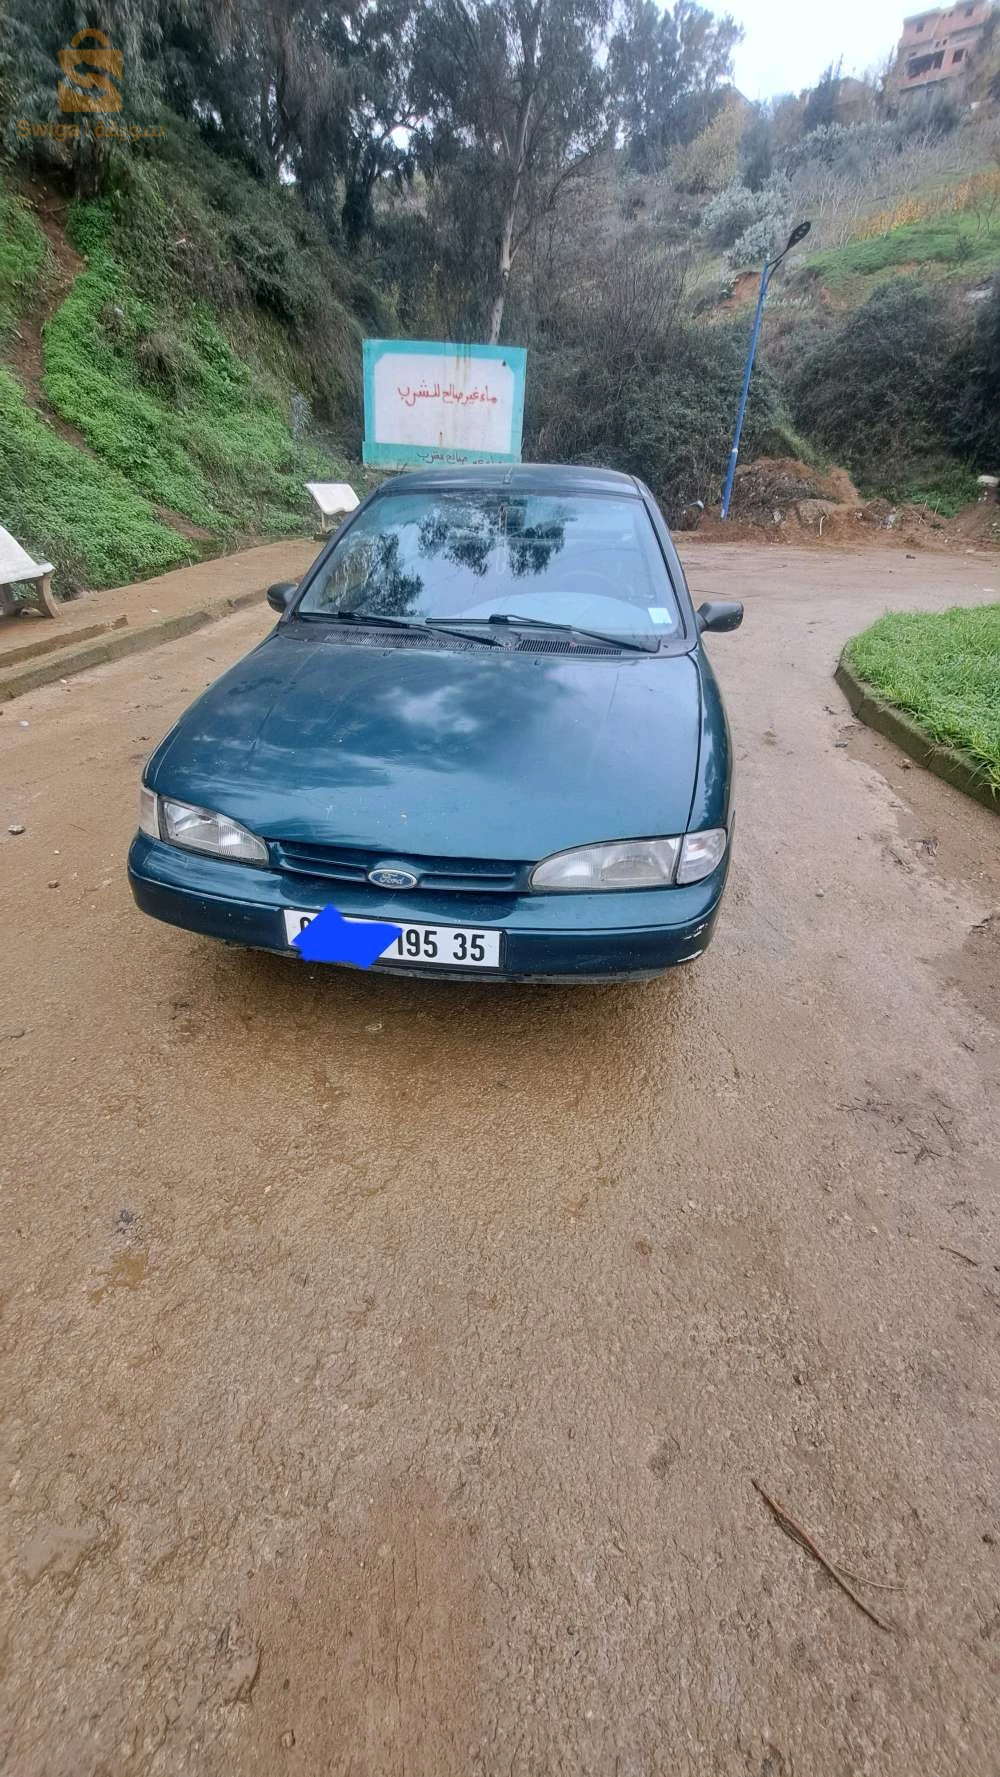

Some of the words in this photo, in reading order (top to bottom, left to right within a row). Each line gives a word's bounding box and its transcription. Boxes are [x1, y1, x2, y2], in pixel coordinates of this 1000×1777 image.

[397, 379, 440, 406] للشرب
[442, 383, 463, 404] صالح
[461, 386, 480, 406] غير
[480, 384, 497, 404] ماء
[379, 872, 406, 886] Ford
[397, 929, 438, 958] 195
[453, 933, 485, 961] 35
